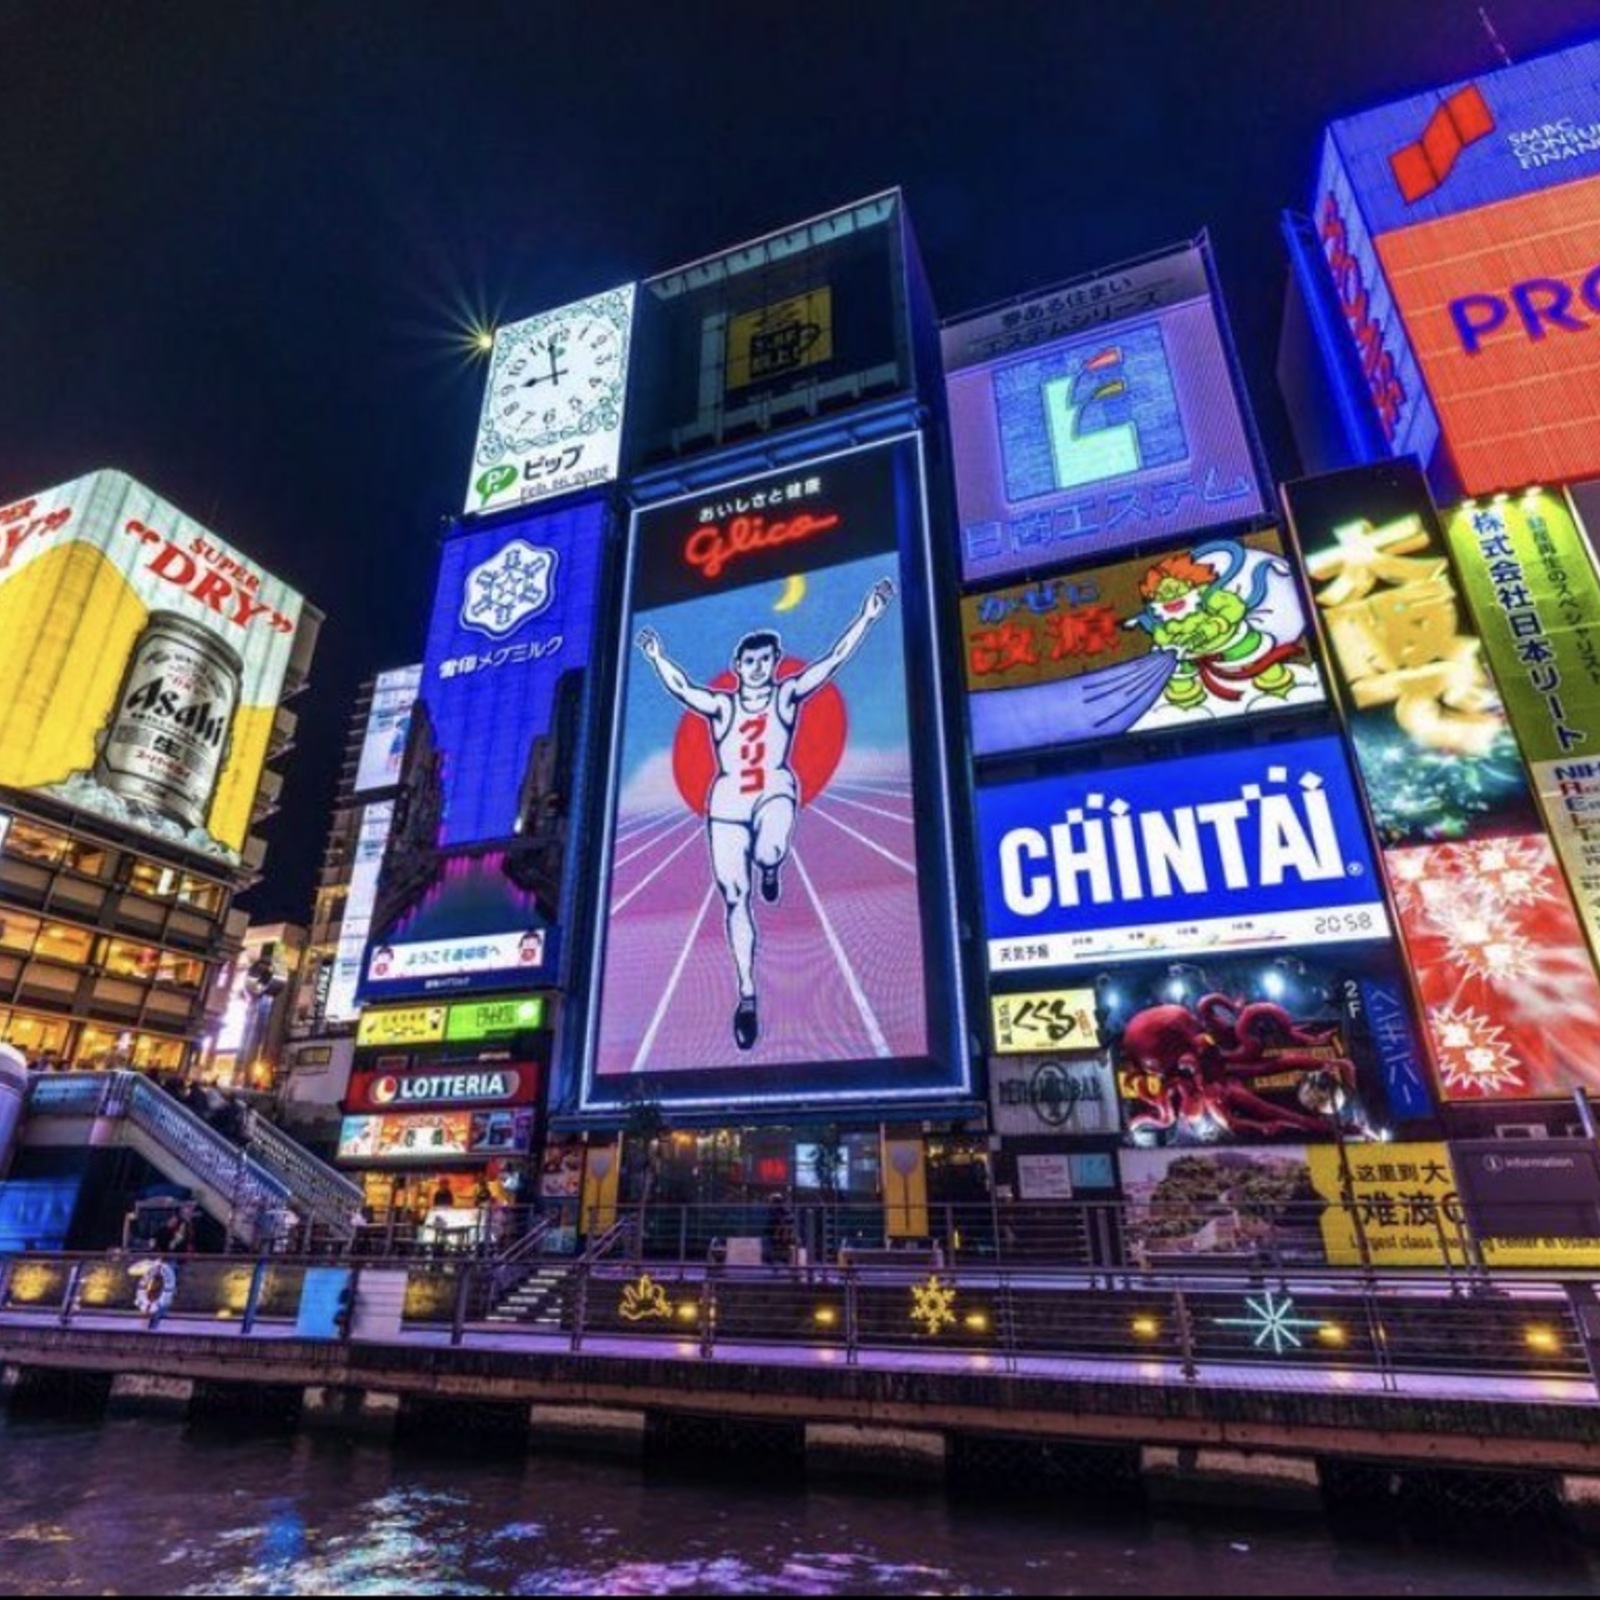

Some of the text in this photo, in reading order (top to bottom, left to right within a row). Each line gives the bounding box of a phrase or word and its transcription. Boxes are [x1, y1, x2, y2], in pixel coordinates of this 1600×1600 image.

[699, 477, 821, 522] おいしさと健康
[190, 537, 262, 590] SUPER
[685, 514, 839, 577] Glico
[970, 604, 1121, 675] 改源
[1471, 511, 1586, 752] 株式会社日本リート
[126, 676, 225, 748] Asahi
[739, 713, 768, 794] グリコ
[998, 766, 1346, 916] CHINTAI
[1013, 999, 1076, 1040] くくる
[400, 1073, 505, 1099] LOTTERIA
[1505, 1156, 1574, 1169] information
